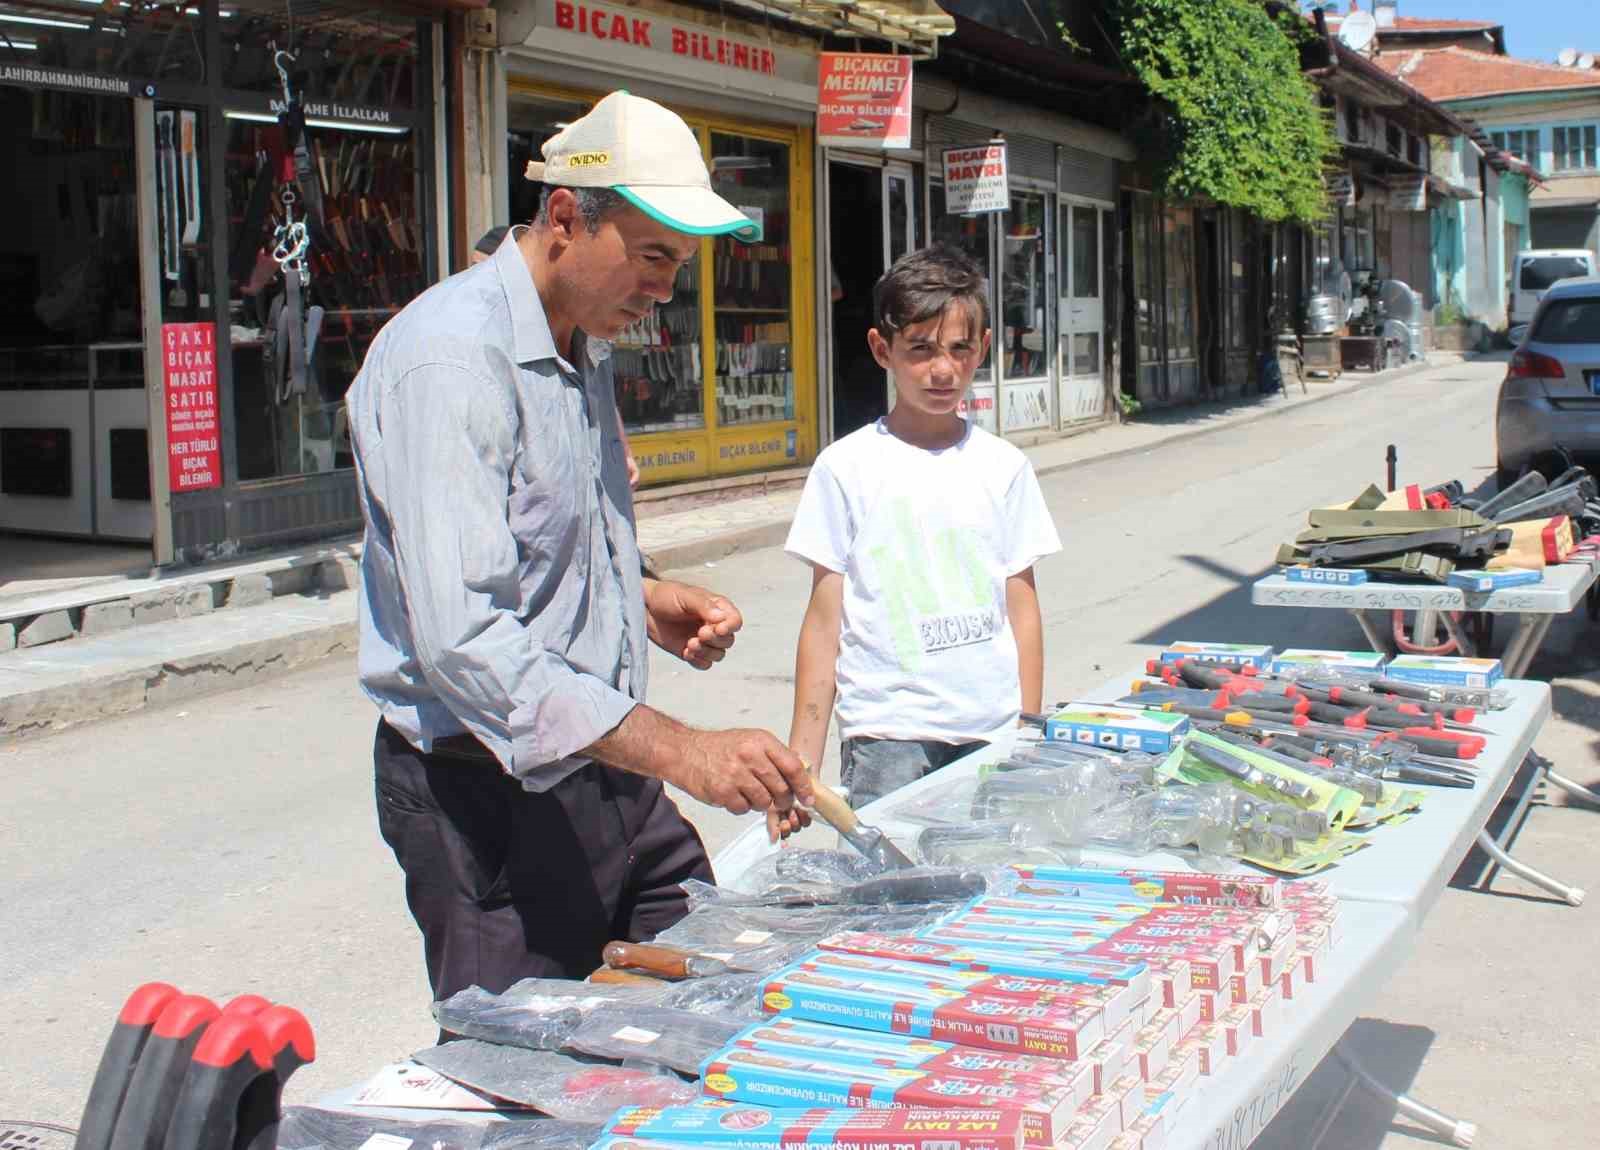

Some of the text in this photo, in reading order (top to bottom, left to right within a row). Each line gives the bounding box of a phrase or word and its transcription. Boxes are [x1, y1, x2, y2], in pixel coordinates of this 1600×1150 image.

[823, 73, 907, 92] MEHMET
[819, 104, 855, 116] BIÇAK
[570, 153, 608, 166] OVIDIO
[167, 330, 212, 349] ÇAKI
[168, 351, 212, 369] BIÇAK
[169, 371, 213, 387] MASAT
[170, 391, 214, 408] SATIR
[171, 437, 217, 455] HER TÜRLÜ
[182, 456, 208, 471] BIÇAK
[657, 448, 696, 466] BİLENİR
[1024, 1039, 1069, 1056] LAZ DAYI
[849, 1096, 864, 1108] İLE
[904, 1122, 998, 1131] LAZ DAYI
